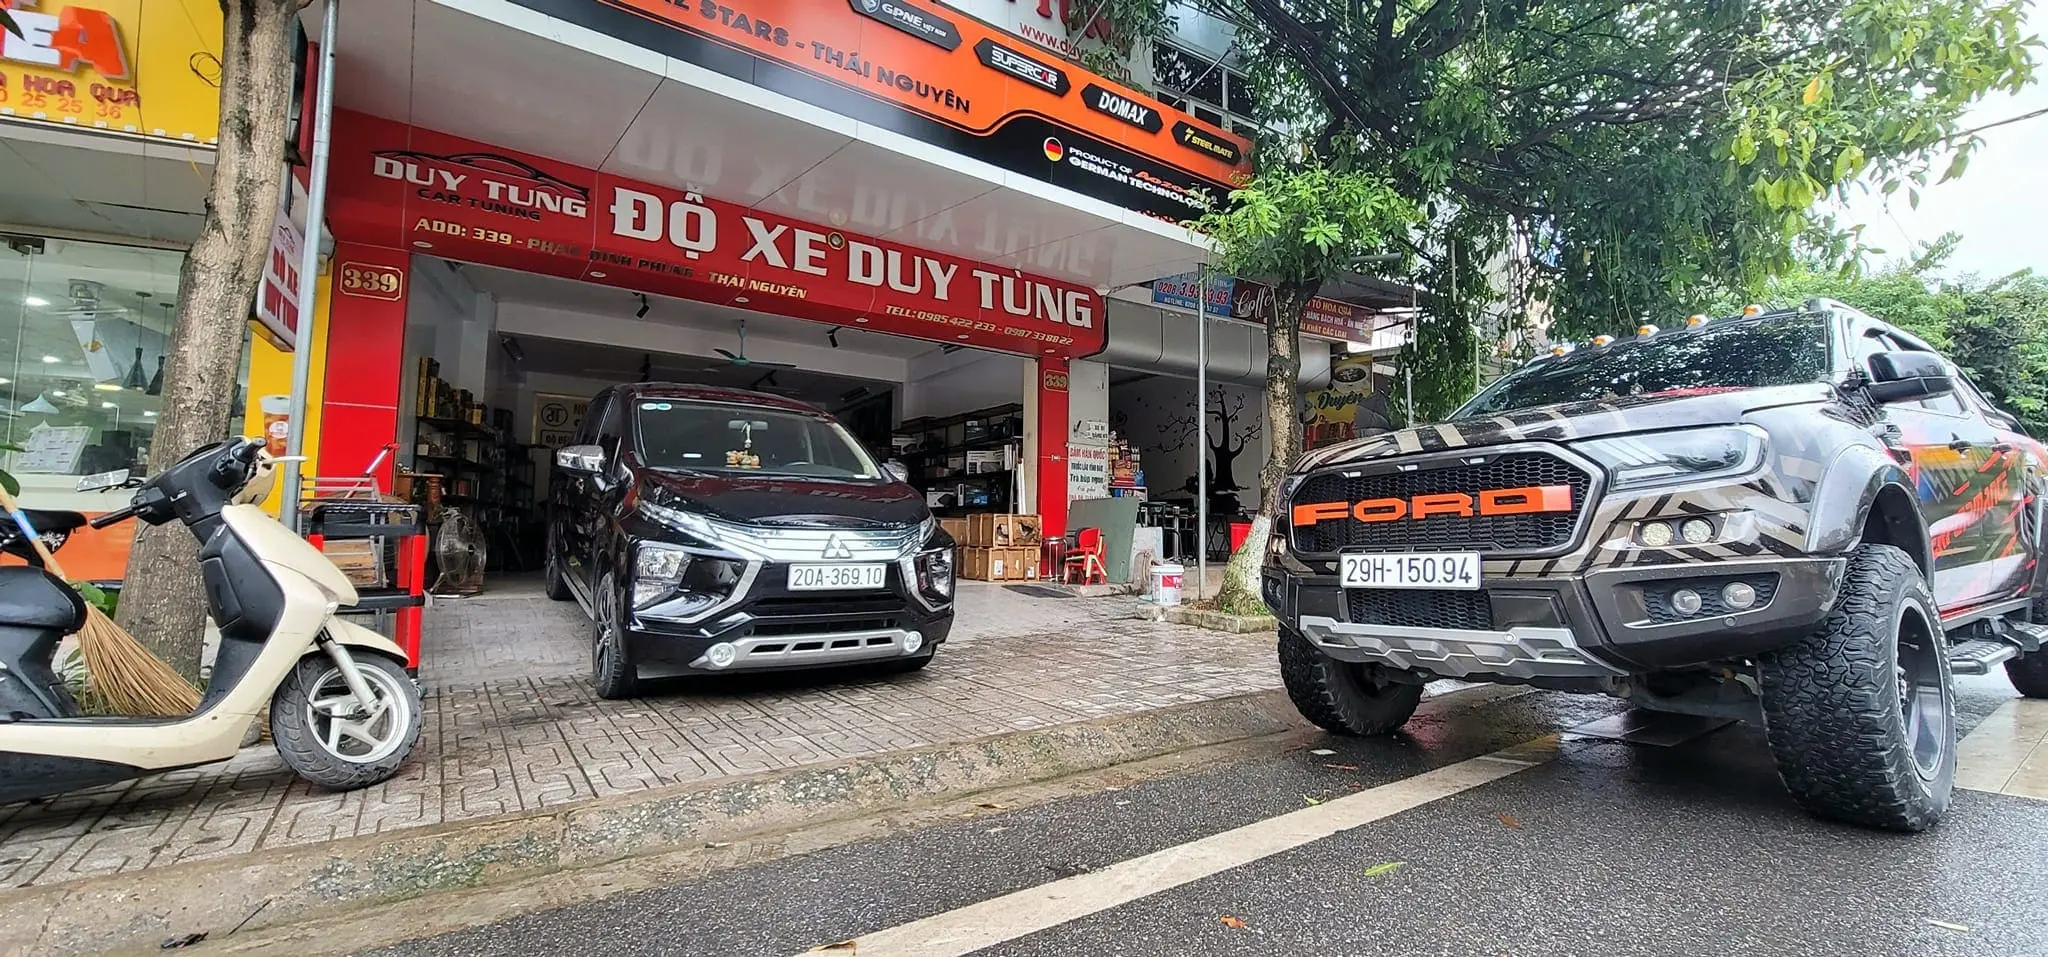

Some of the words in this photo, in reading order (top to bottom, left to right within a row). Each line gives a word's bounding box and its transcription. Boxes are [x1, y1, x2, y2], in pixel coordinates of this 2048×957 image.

[881, 2, 924, 27] GPNE
[699, 0, 789, 46] STARS
[811, 40, 870, 78] THÁI
[877, 66, 970, 114] NGUYÊN
[991, 49, 1058, 87] SUPERCAR
[23, 73, 76, 98] HOA
[21, 92, 47, 108] 25
[56, 98, 83, 113] 25
[96, 103, 121, 119] 36
[1098, 91, 1149, 126] DOMAX
[1068, 156, 1128, 183] GERMAN
[1069, 147, 1119, 170] PRODUCT
[1120, 165, 1134, 175] OF
[374, 156, 467, 192] DUY
[482, 180, 587, 219] TUNG
[417, 188, 461, 206] CAR
[468, 199, 542, 222] TUNING
[414, 218, 467, 237] ADD:
[472, 227, 512, 245] 339
[749, 279, 808, 300] NGUYÊN
[610, 186, 717, 260] ĐỘ
[741, 215, 828, 277] XE
[848, 240, 958, 301] DUY
[972, 268, 1093, 329] TÙNG
[344, 268, 399, 293] 339
[1293, 484, 1573, 528] FORD
[793, 567, 882, 587] 20A-369.10
[1346, 556, 1473, 584] 29H-150.94
